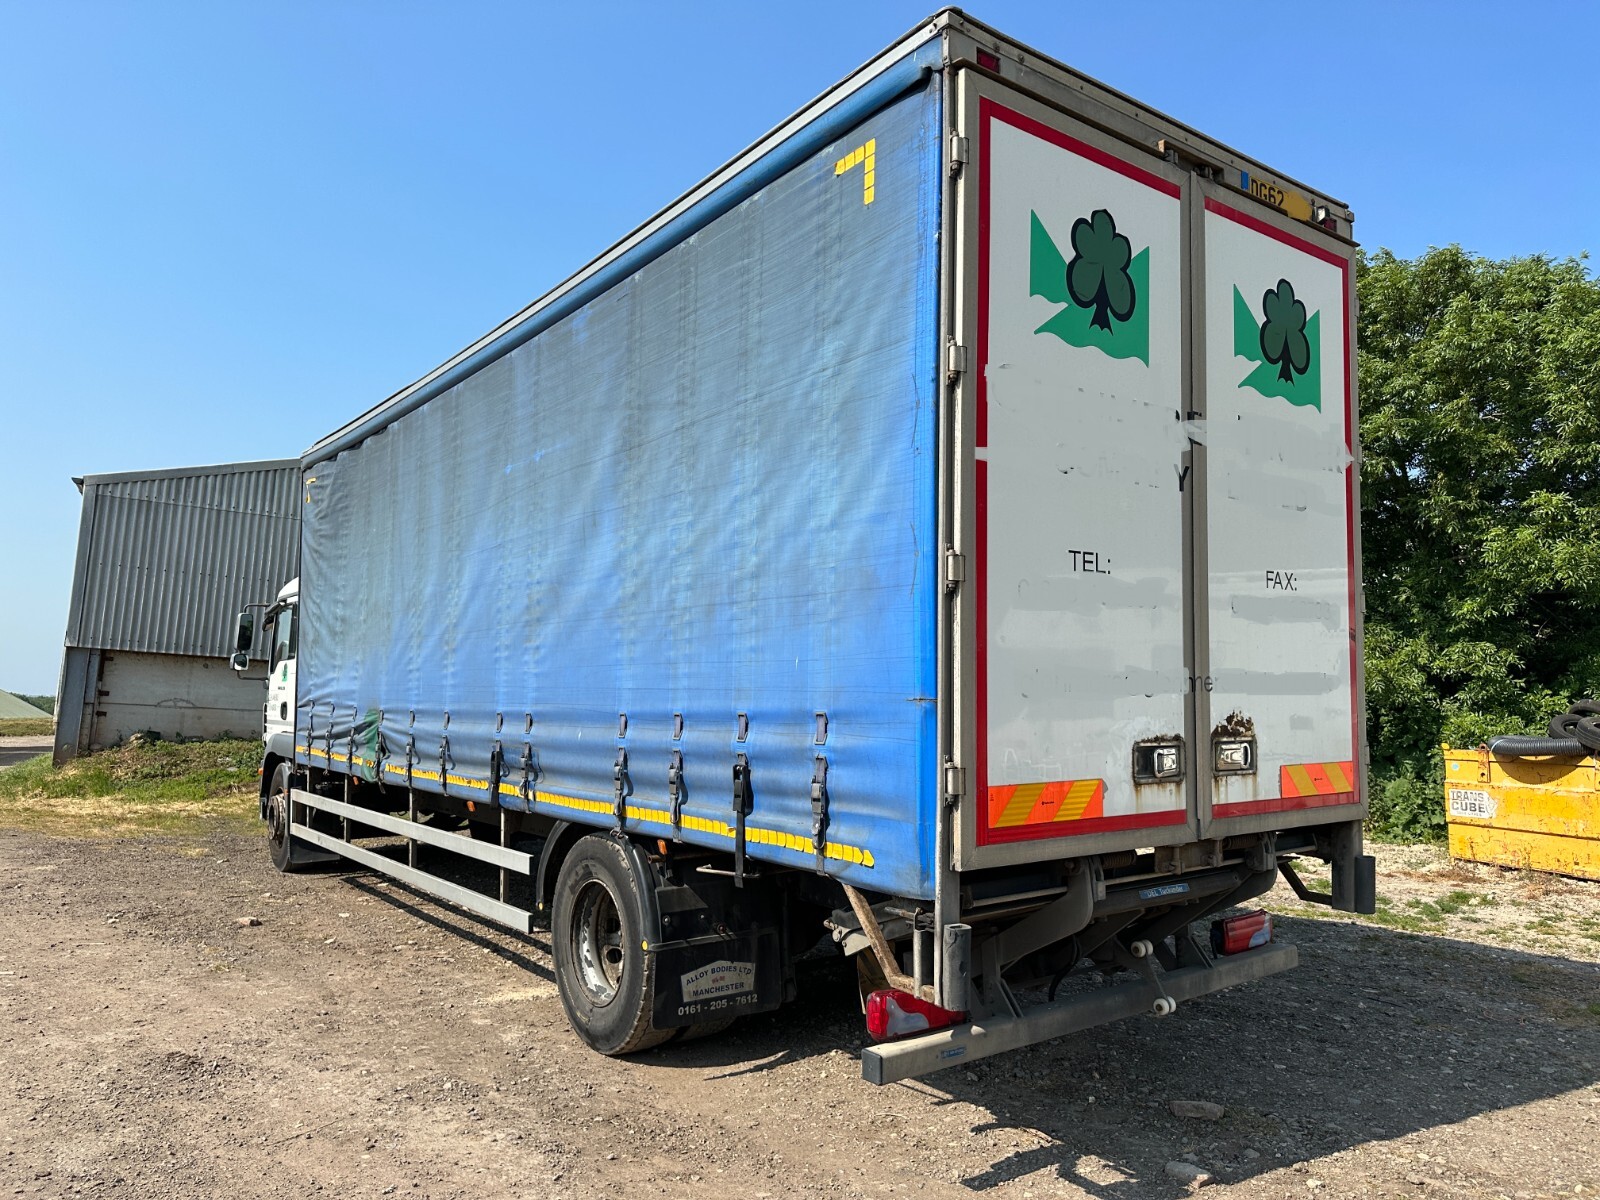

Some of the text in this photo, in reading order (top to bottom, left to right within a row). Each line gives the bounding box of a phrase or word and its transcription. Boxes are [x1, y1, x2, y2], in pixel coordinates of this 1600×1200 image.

[1250, 178, 1284, 207] DG62
[1068, 550, 1111, 575] TEL:
[1265, 570, 1298, 591] FAX:
[1451, 790, 1484, 802] TRANS
[1451, 801, 1486, 813] CUBE
[686, 970, 709, 986] ALLOY
[711, 965, 737, 975] BODIES
[739, 966, 752, 975] LTD
[692, 982, 745, 997] MANCHESTER
[678, 1004, 701, 1016] 0161
[710, 999, 728, 1011] 205
[736, 993, 758, 1006] 7612
